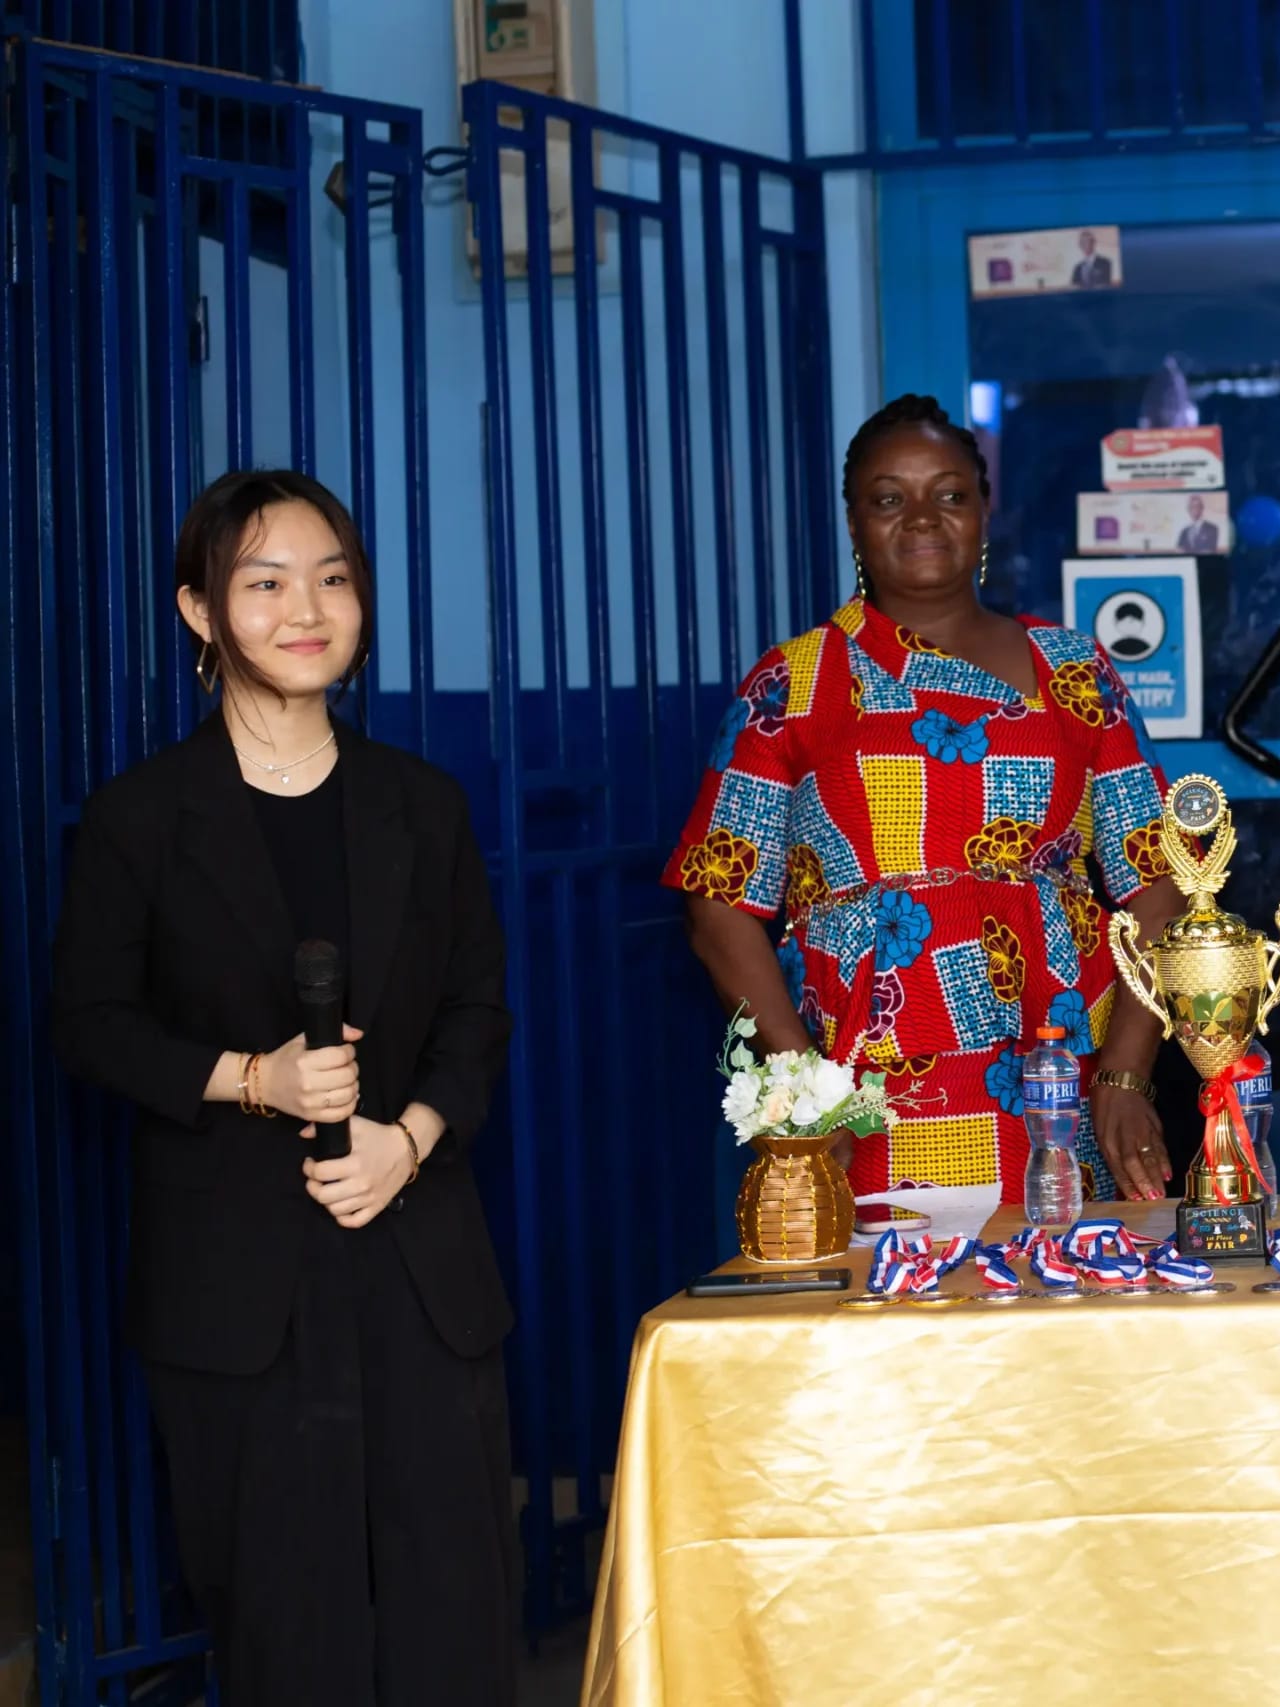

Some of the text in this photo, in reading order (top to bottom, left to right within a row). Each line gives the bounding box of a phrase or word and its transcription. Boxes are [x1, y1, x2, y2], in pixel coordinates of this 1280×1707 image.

[1129, 687, 1177, 708] NTRY
[1191, 1208, 1244, 1218] SCIENCE
[1207, 1241, 1235, 1250] FAIR
